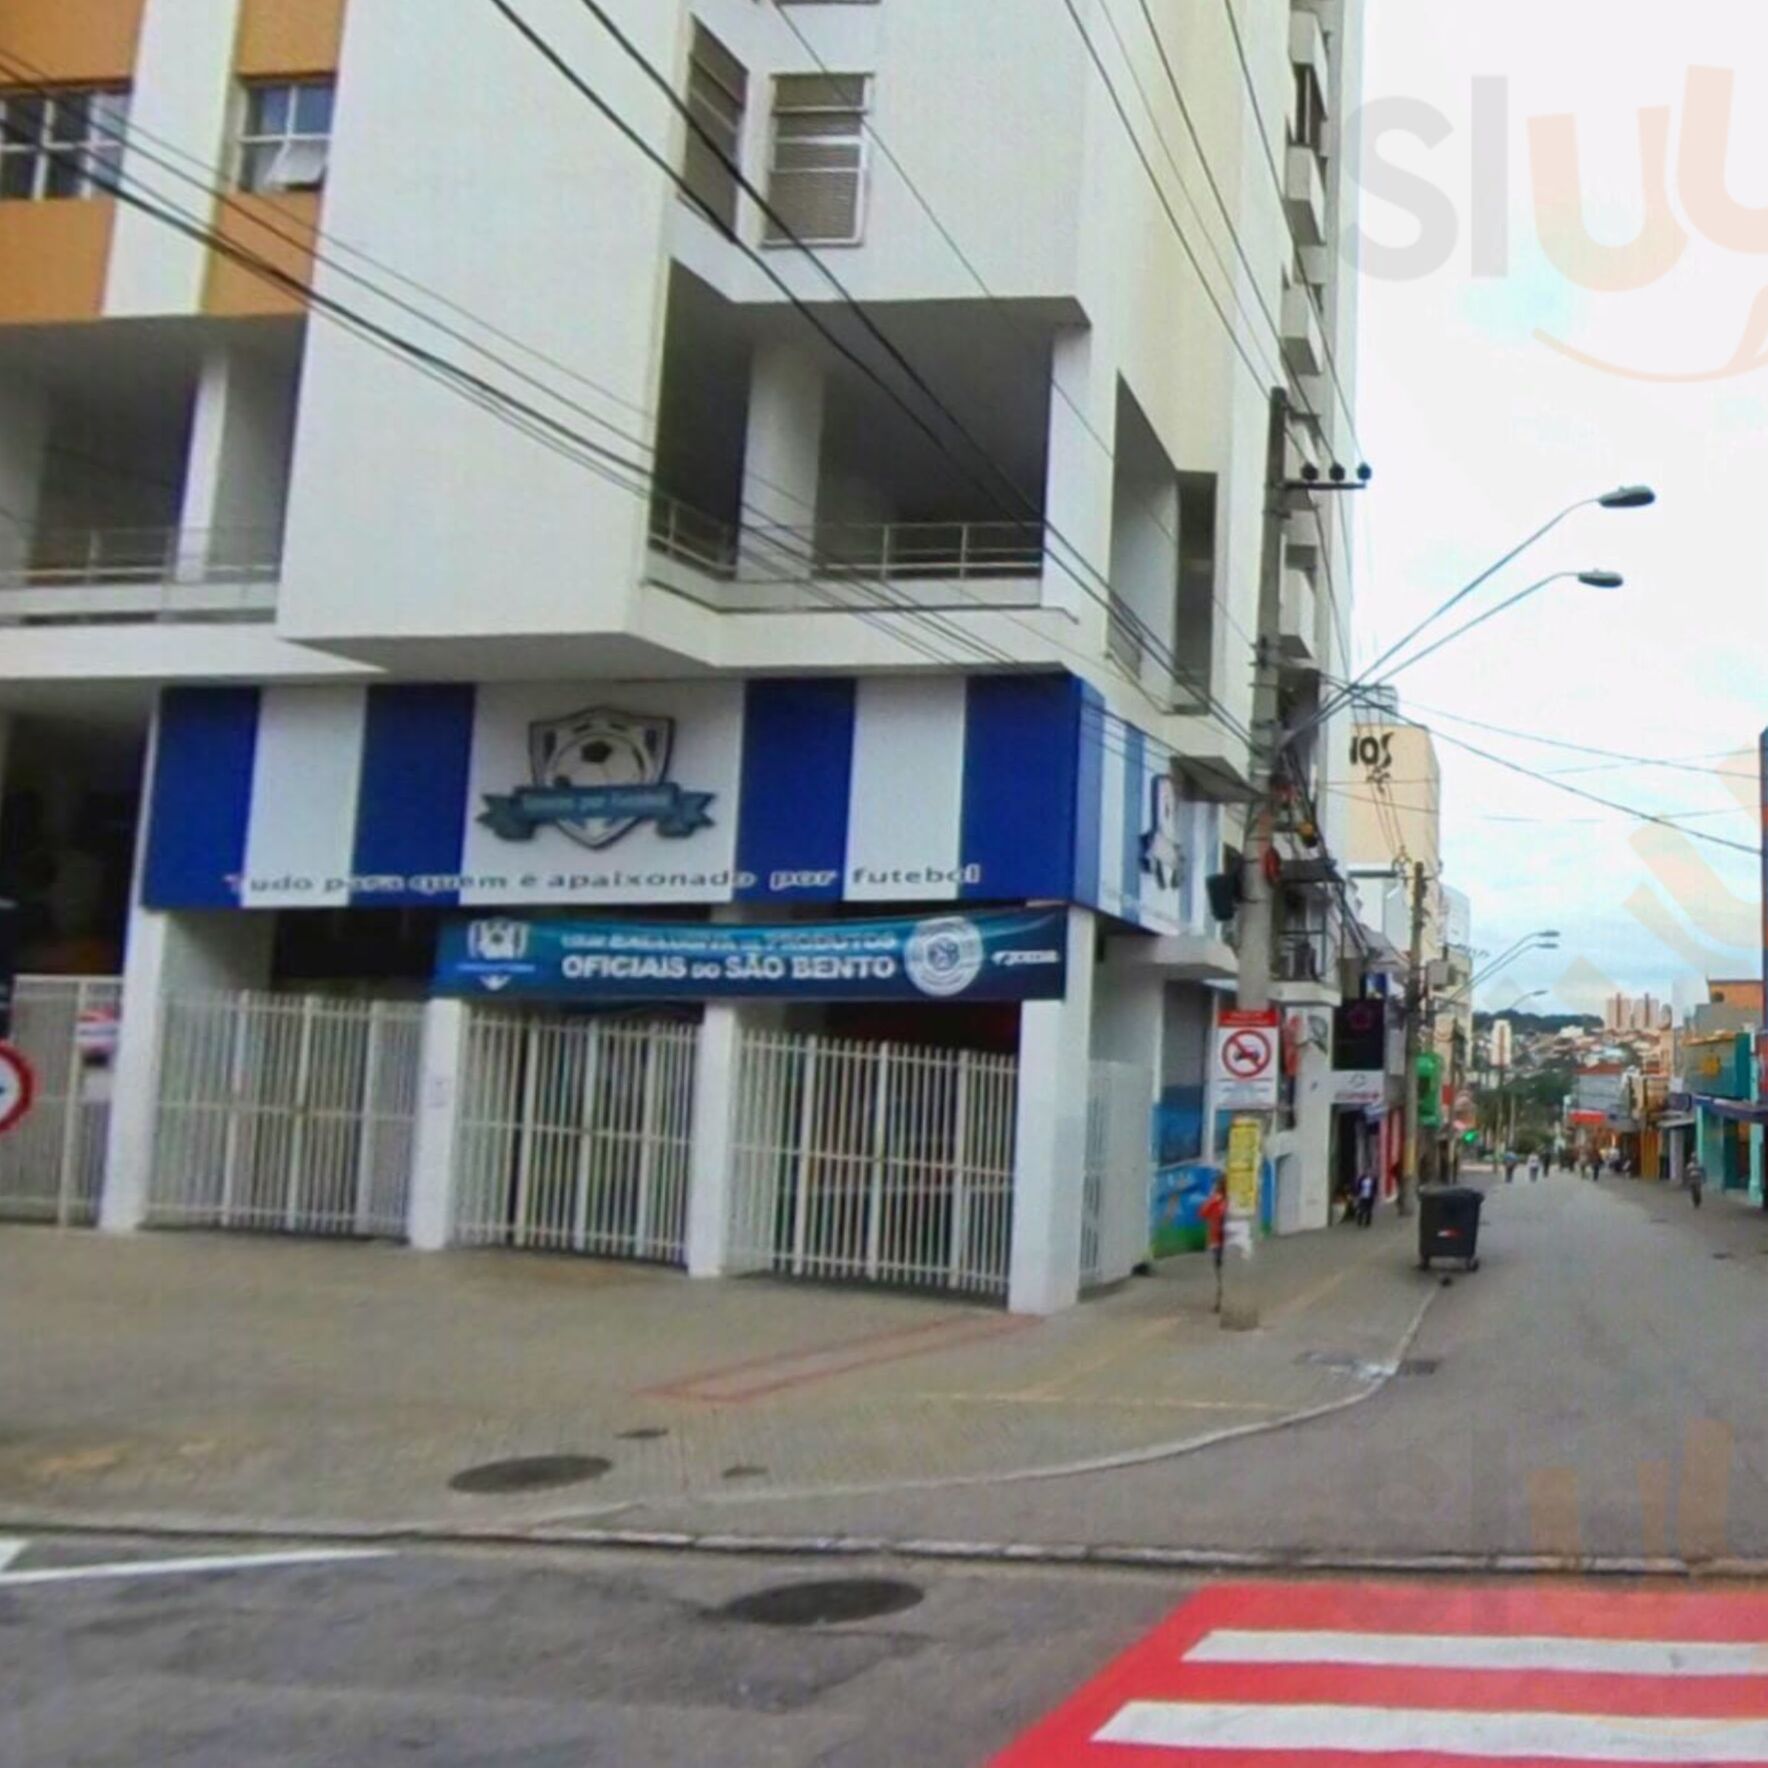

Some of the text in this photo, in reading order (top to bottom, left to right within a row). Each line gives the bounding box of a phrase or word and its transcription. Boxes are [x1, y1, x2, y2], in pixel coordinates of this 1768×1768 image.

[221, 872, 313, 894] Tudo
[548, 869, 757, 892] apaixonado
[768, 869, 838, 891] por
[853, 863, 982, 885] futebol
[562, 950, 897, 980] OFICIAIS DO SÃO BENTO
